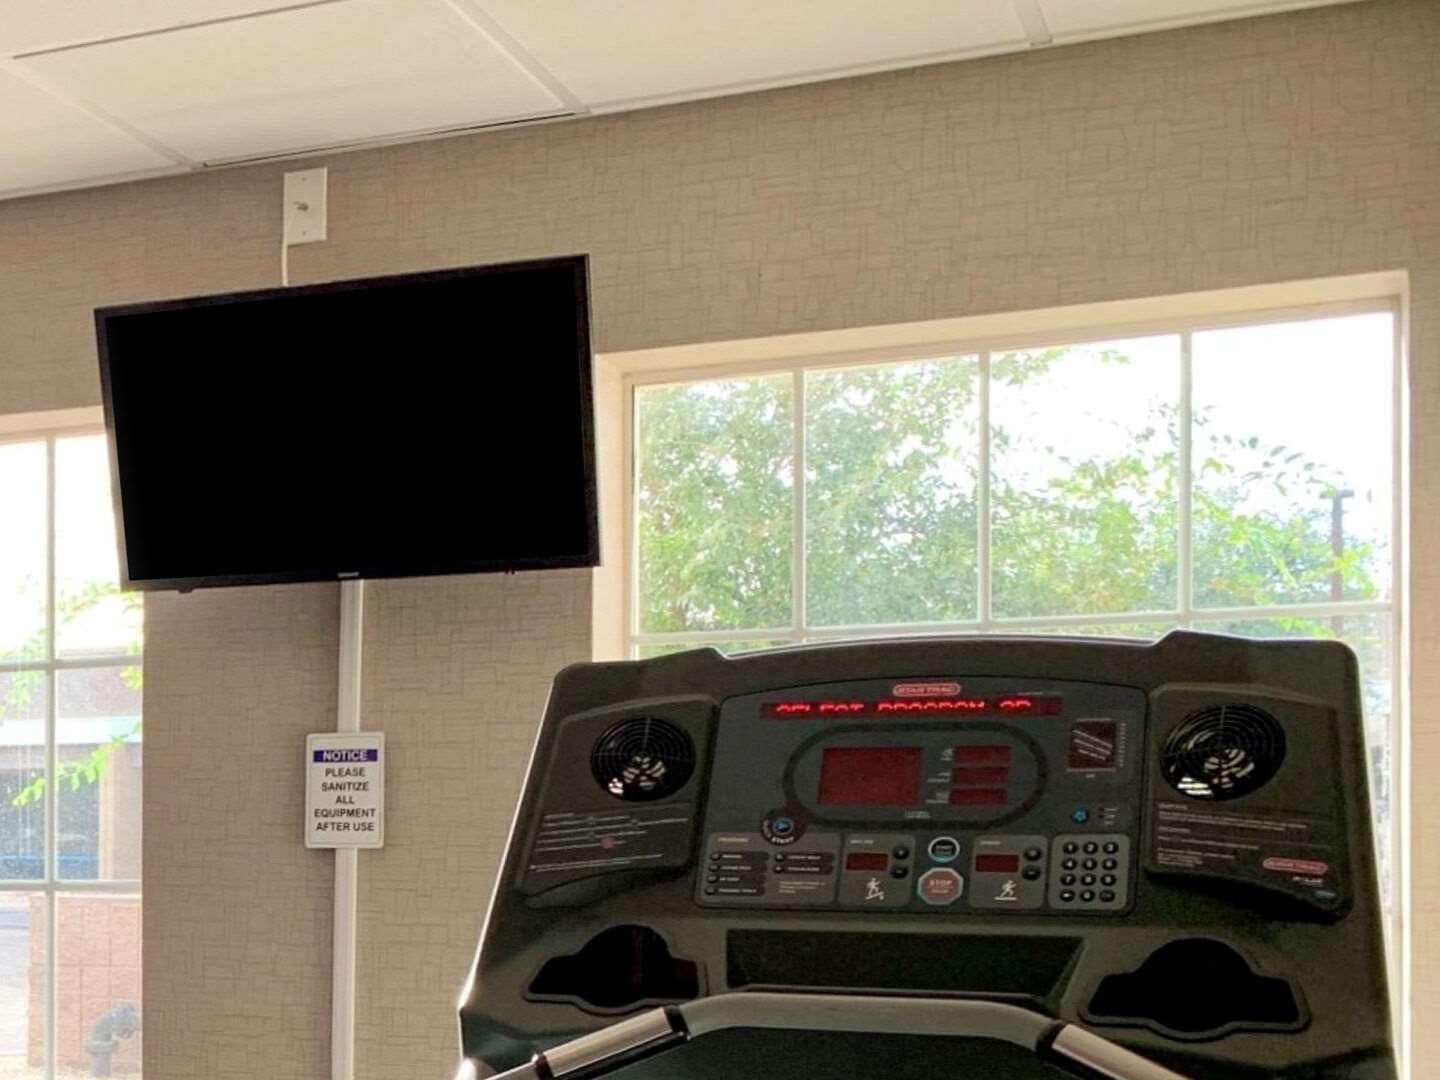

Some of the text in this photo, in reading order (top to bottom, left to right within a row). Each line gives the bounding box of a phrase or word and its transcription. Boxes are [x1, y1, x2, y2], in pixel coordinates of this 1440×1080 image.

[323, 750, 369, 761] NOTICE
[325, 767, 366, 777] PLEASE
[321, 781, 369, 791] SANITIZE
[336, 795, 355, 805] ALL
[314, 808, 376, 818] EQUIPMENT
[316, 822, 375, 832] AFTER USE
